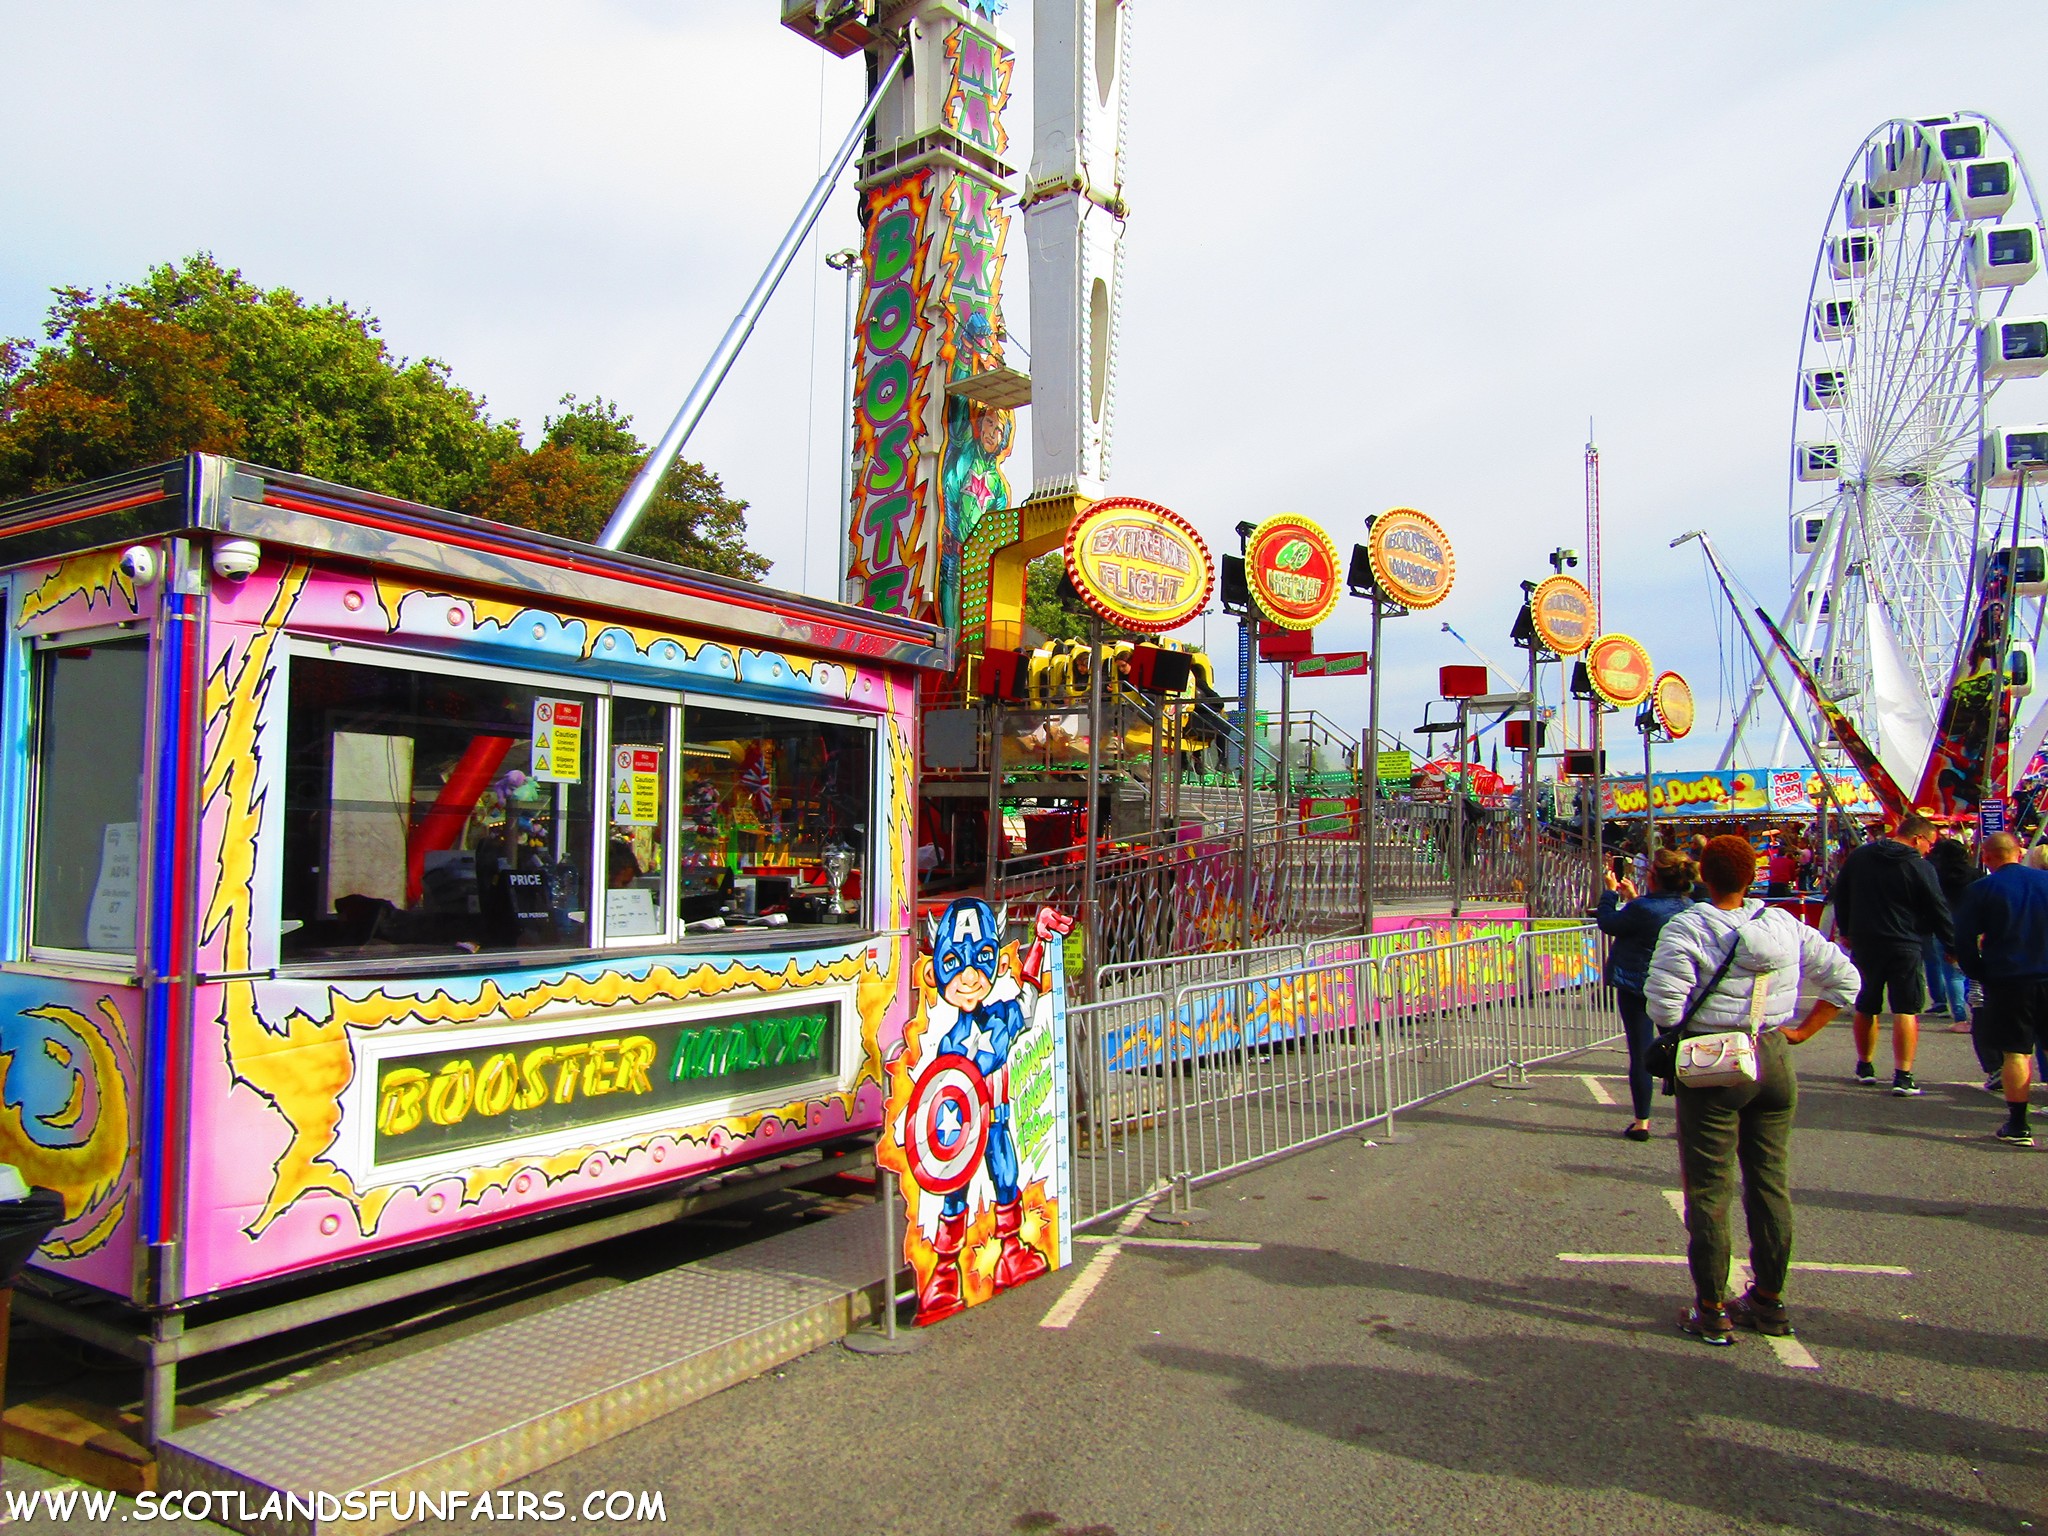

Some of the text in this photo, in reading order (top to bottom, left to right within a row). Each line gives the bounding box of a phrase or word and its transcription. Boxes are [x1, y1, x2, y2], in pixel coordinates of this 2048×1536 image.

[1091, 525, 1190, 575] EXTREME
[1385, 531, 1444, 565] BOOSTER
[1098, 560, 1184, 604] FLIGHT
[556, 715, 578, 723] running
[1773, 772, 1800, 783] Prize
[1774, 783, 1801, 796] Every
[510, 874, 542, 886] PRICE
[378, 1014, 828, 1136] BOOSTER MAXXX
